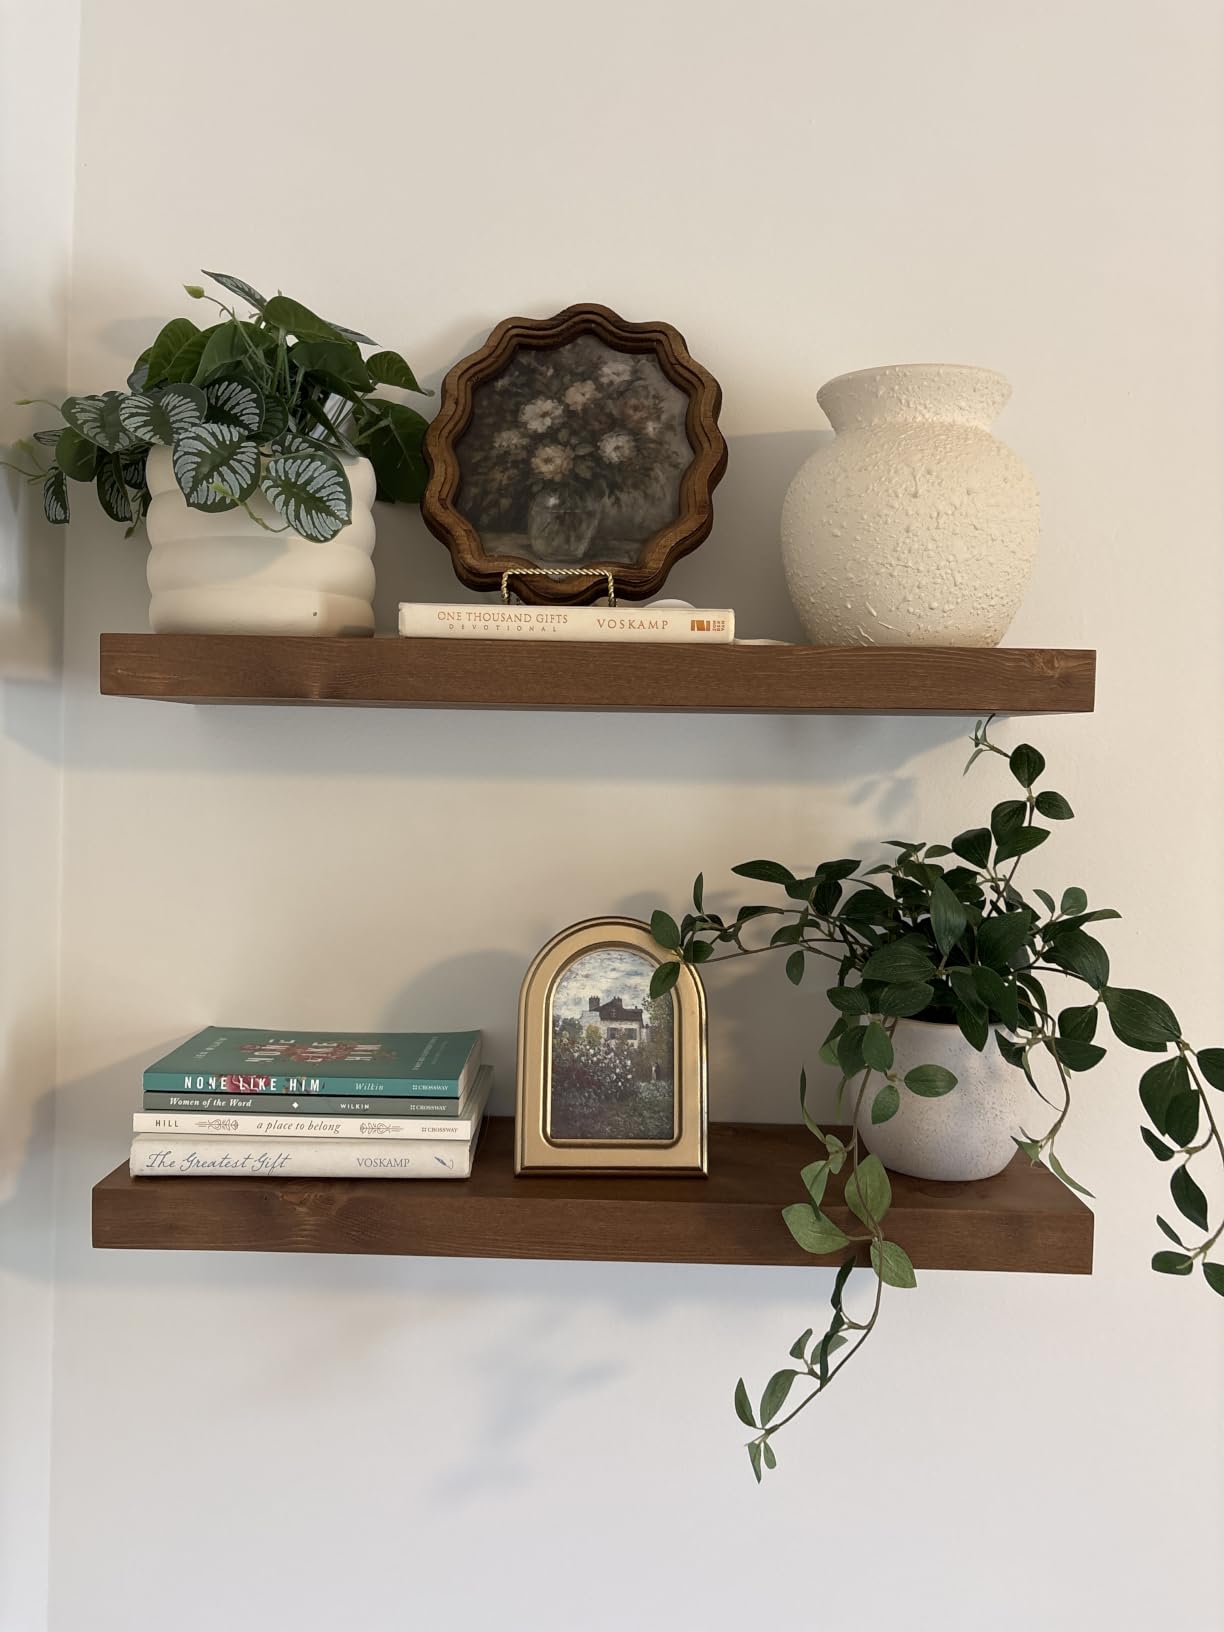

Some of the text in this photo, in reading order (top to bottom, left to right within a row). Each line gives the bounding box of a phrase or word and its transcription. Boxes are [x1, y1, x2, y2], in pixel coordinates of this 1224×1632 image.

[437, 611, 568, 624] ONE THOUSAND GIFTS
[448, 623, 557, 632] DEVOTIONAL
[597, 618, 669, 630] VOSKAMP
[184, 1076, 320, 1092] NONE LIKE HIM
[355, 1082, 384, 1091] Wilkin
[169, 1097, 253, 1108] Women of the Word
[155, 1119, 179, 1128] HILL
[256, 1120, 341, 1134] a place to belong
[145, 1151, 292, 1175] The Greatest Gift
[357, 1157, 410, 1168] VOSKAMP
